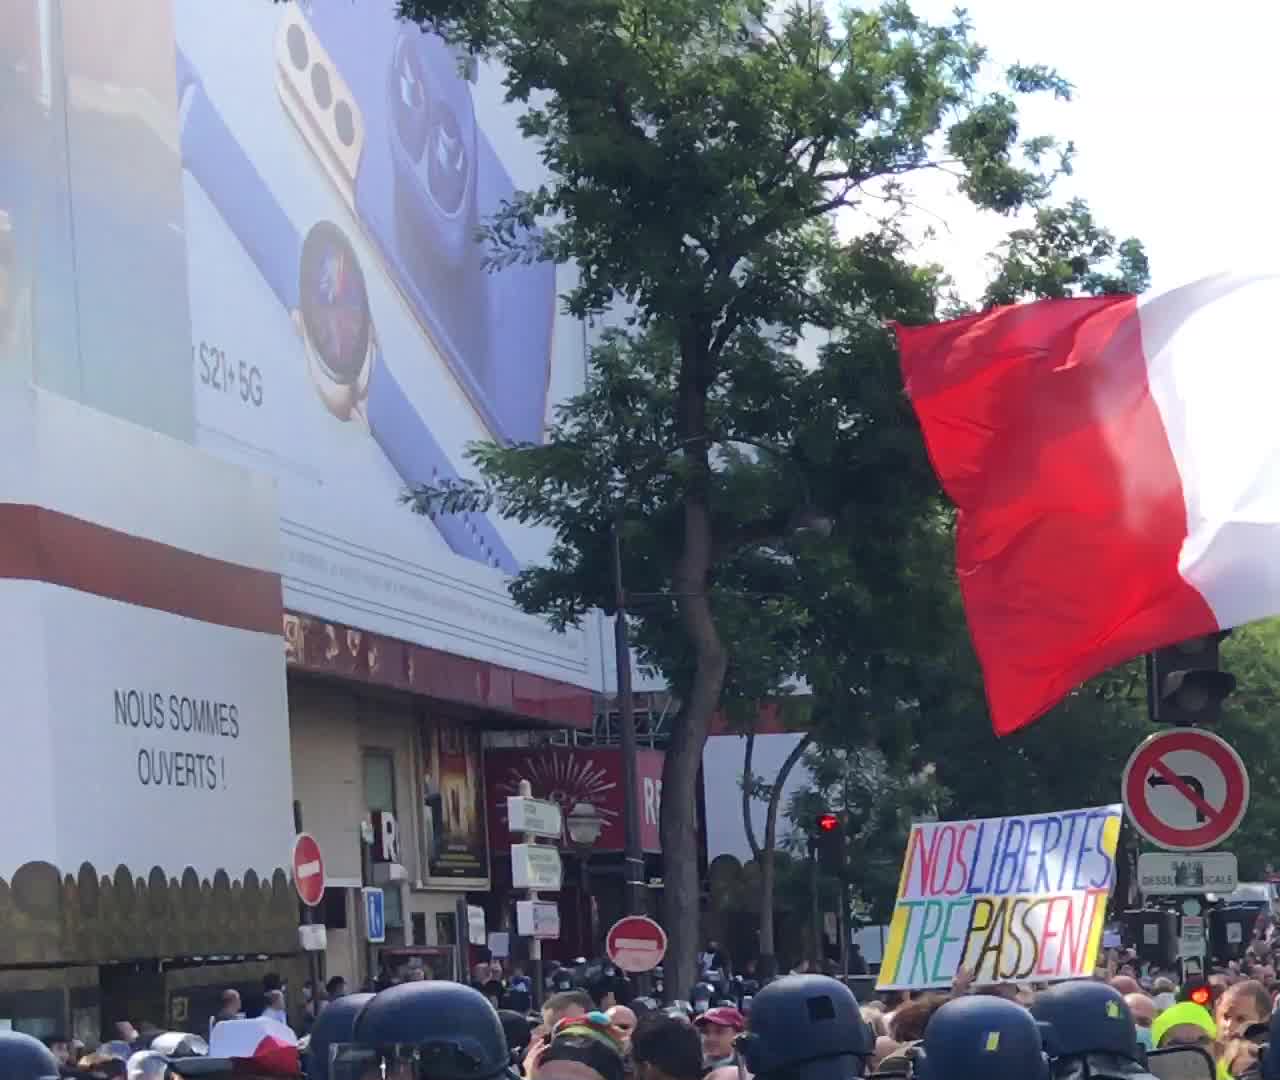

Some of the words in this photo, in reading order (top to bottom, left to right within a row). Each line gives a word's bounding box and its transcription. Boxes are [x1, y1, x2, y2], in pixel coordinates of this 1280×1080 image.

[238, 360, 264, 408] 5G
[114, 689, 165, 729] NOUS
[168, 694, 240, 739] SOMMES
[137, 748, 217, 790] OUVERTS
[903, 823, 976, 897] NOS
